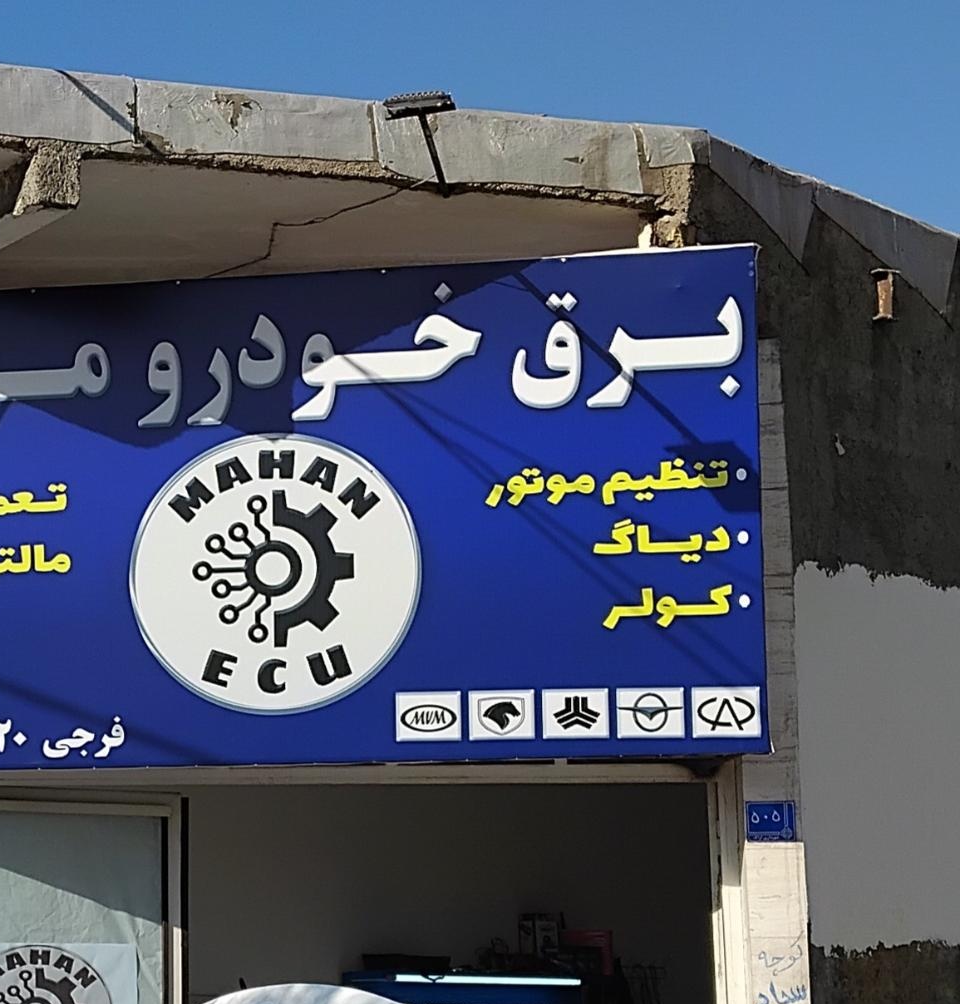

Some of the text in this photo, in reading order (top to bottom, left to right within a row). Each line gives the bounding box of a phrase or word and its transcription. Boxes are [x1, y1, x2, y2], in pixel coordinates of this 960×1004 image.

[138, 282, 482, 427] خودرو
[512, 292, 742, 408] برق
[168, 450, 381, 523] MAHAN
[485, 457, 728, 507] تنظیم موتور
[593, 519, 730, 563] دیاگ
[602, 584, 732, 629] کولر
[201, 644, 353, 694] ECU
[43, 716, 124, 758] فرجی
[410, 709, 447, 726] MVM
